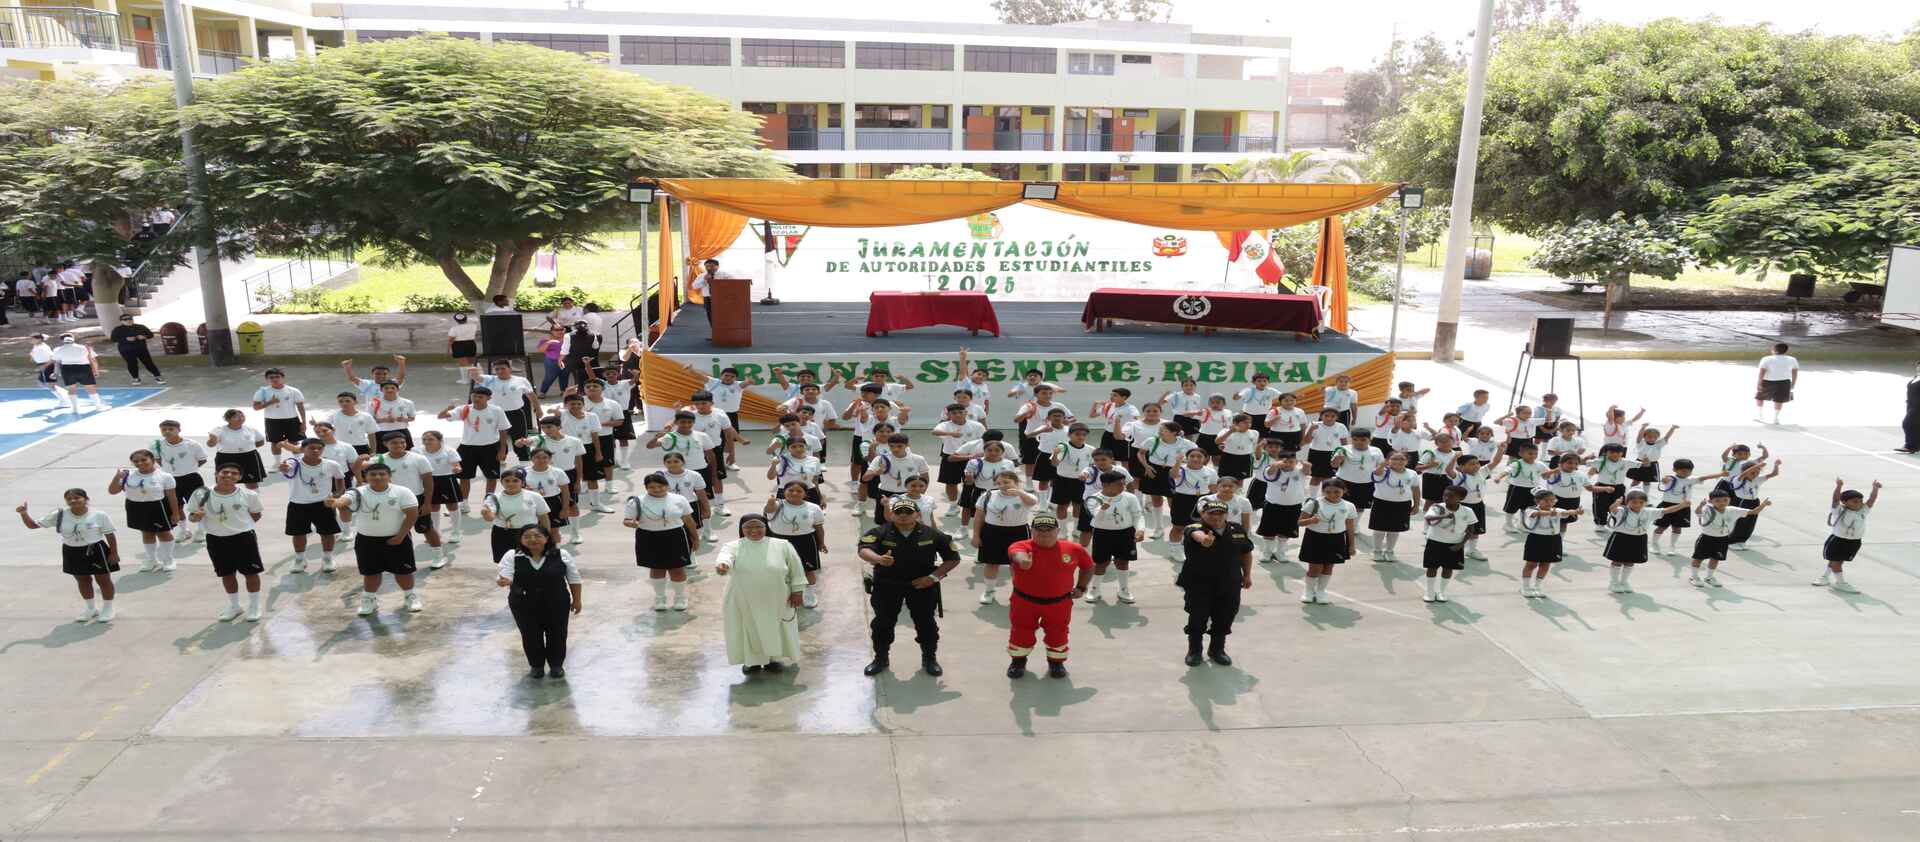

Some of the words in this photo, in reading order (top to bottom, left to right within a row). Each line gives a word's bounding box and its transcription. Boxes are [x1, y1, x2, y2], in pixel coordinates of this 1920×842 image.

[826, 261, 849, 273] DE
[859, 261, 985, 273] AUTORIDADES
[1000, 260, 1152, 272] ESTUDIANTILES
[937, 275, 1015, 294] 2025
[1162, 355, 1327, 384] REINA!
